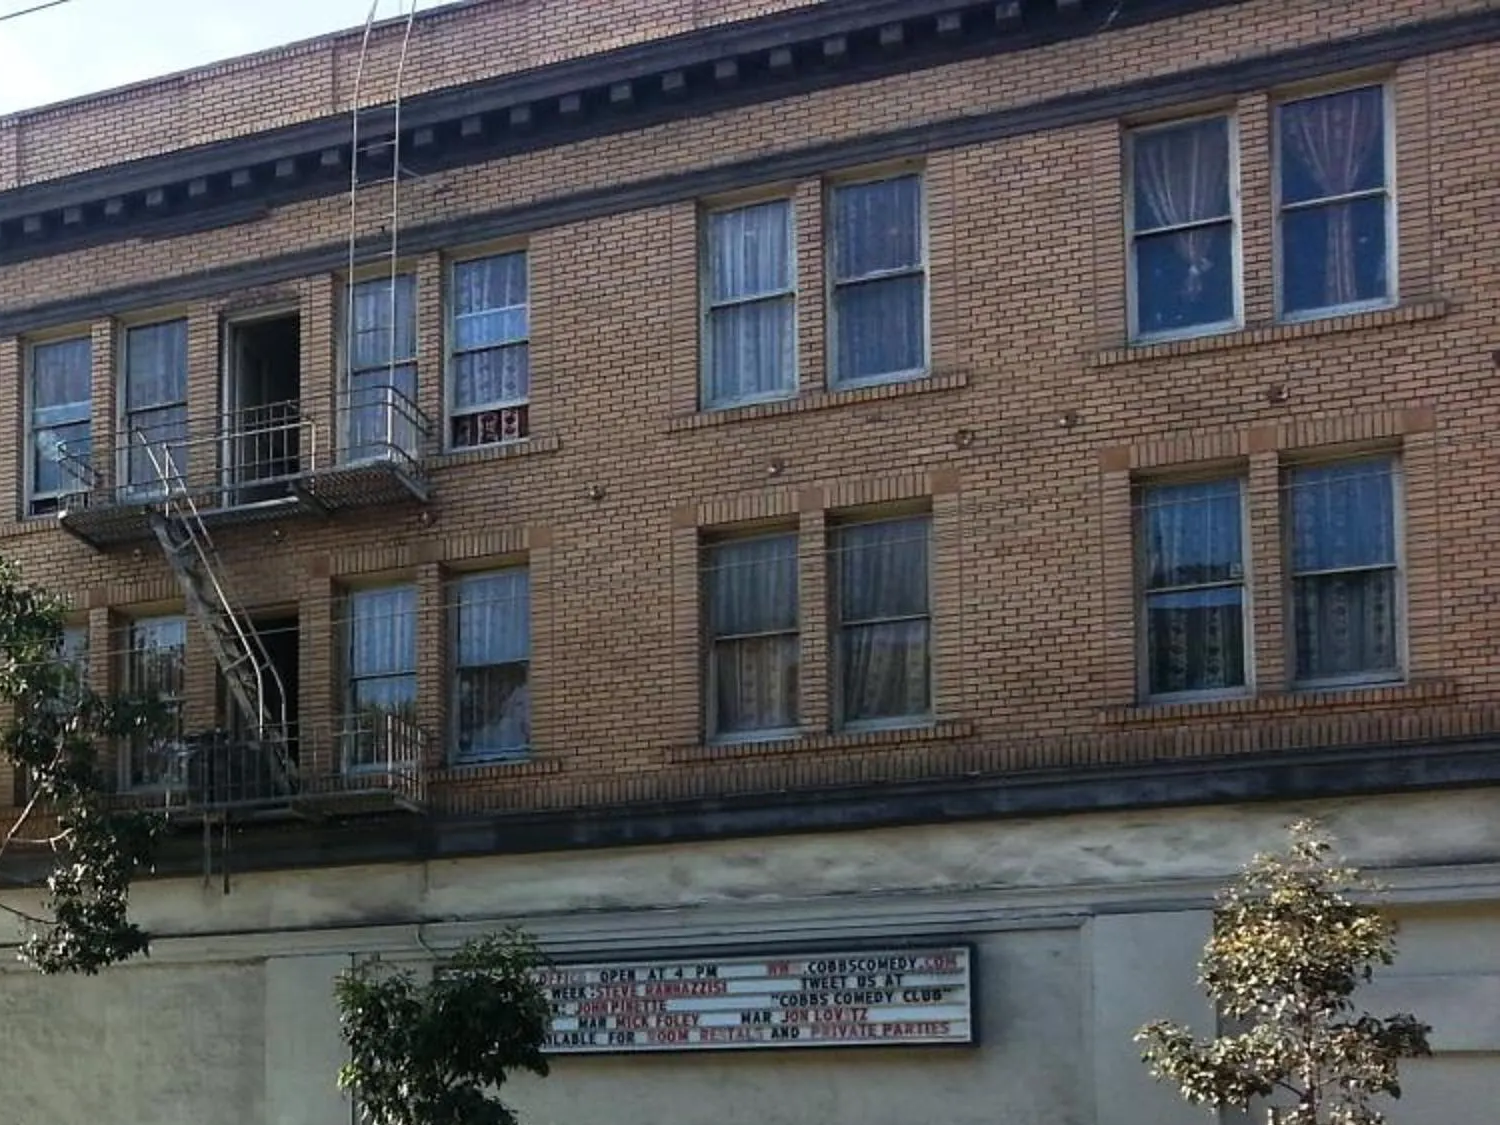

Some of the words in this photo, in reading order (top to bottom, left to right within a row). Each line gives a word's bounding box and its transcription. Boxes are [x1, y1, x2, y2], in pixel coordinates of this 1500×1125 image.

[768, 956, 958, 976] WW.COBBSCOMEDY.COM
[539, 971, 585, 986] OFFI
[601, 968, 635, 983] OPEN
[648, 967, 664, 979] AT
[674, 966, 683, 978] 4
[696, 964, 717, 977] PM
[801, 976, 847, 989] TWEET
[857, 975, 877, 987] US
[885, 974, 904, 986] AT
[598, 984, 637, 998] STEVE
[834, 990, 894, 1005] COMEDY
[579, 1001, 607, 1014] JOHN
[611, 999, 667, 1013] PINETTE
[616, 1013, 649, 1028] MICK
[656, 1012, 699, 1026] FOLEY
[741, 1011, 771, 1024] MAR
[781, 1009, 808, 1023] JON
[815, 1007, 868, 1021] LOVTZ
[609, 1030, 635, 1044] FOR
[648, 1028, 688, 1042] OOM
[772, 1026, 800, 1039] AND
[883, 1021, 950, 1036] PARTIES
